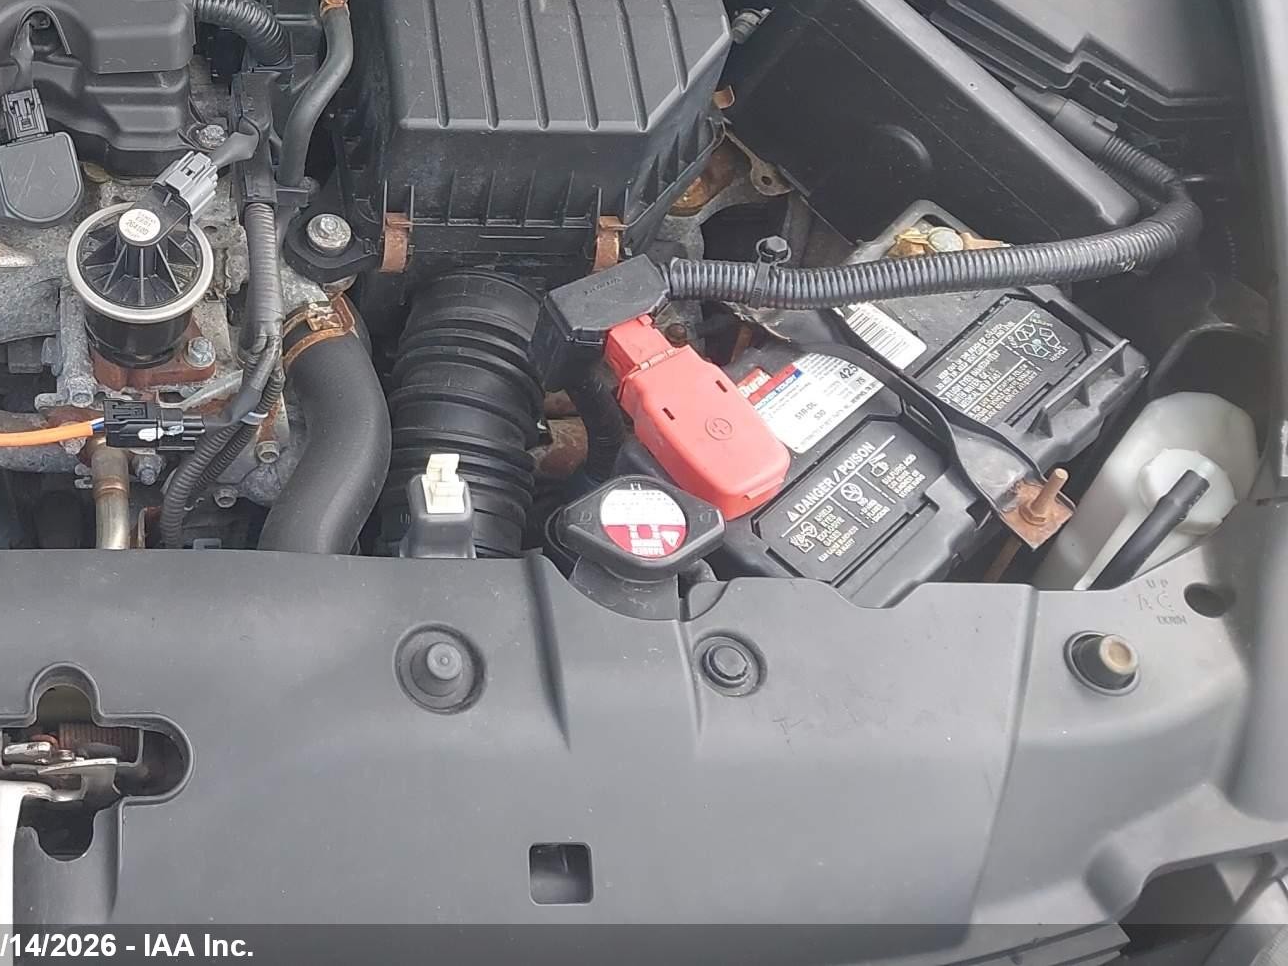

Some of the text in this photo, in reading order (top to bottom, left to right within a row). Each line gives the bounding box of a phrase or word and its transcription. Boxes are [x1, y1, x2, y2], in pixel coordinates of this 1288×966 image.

[839, 363, 859, 380] 425
[795, 477, 836, 514] DANGER
[838, 441, 876, 475] POISON
